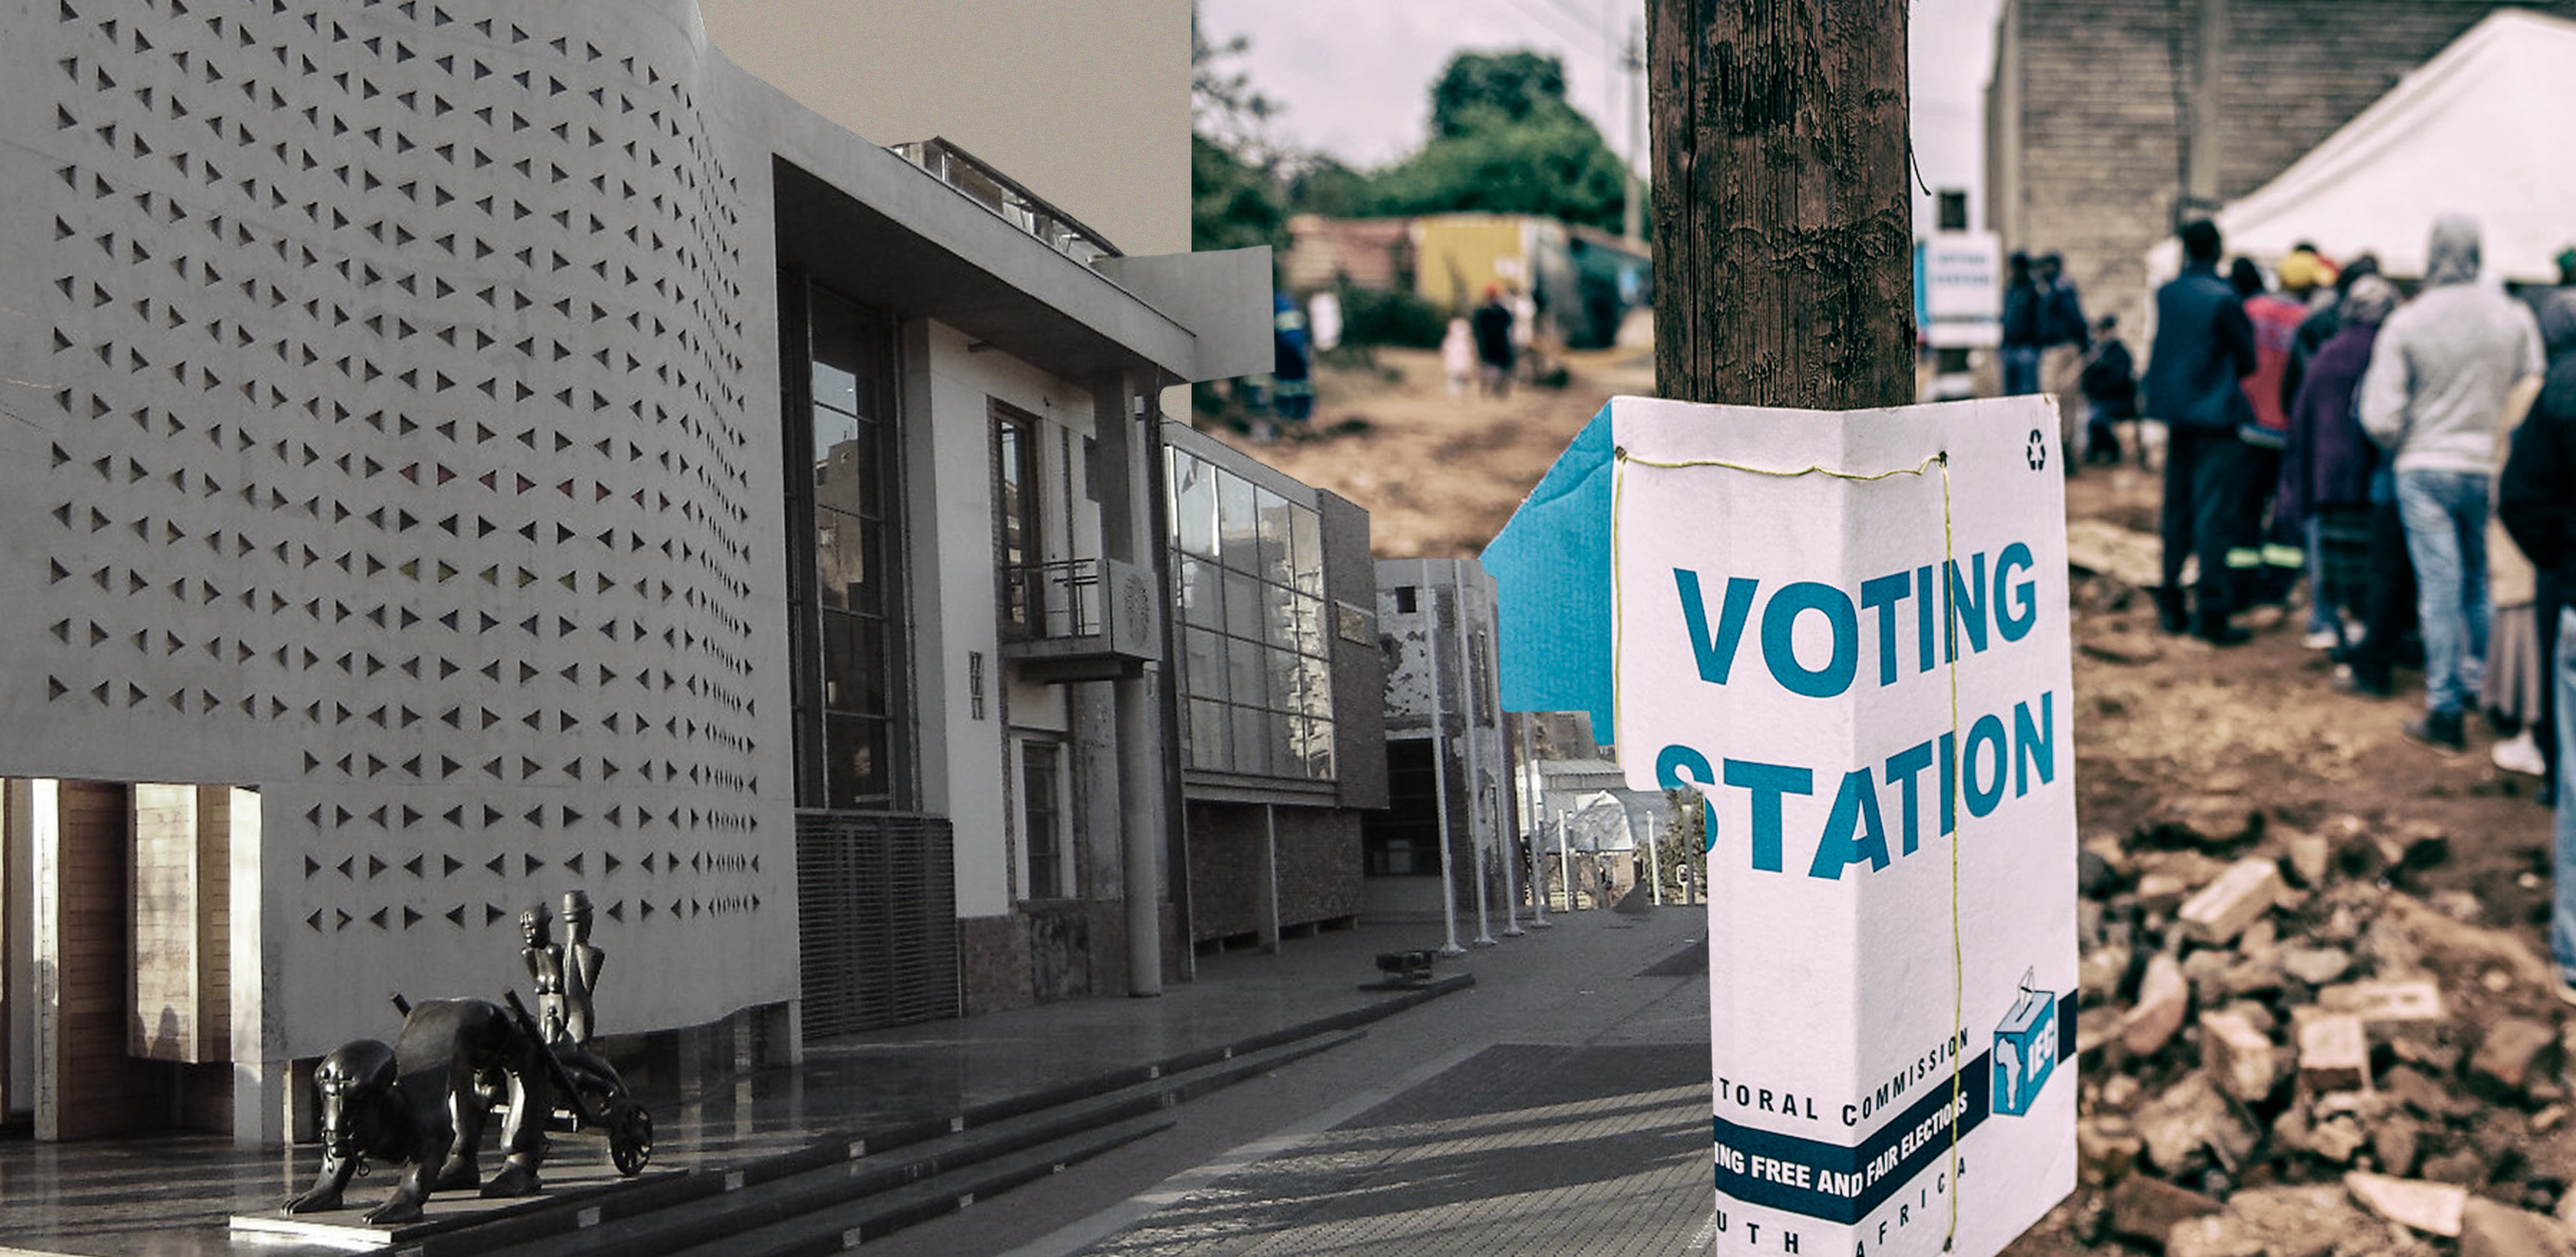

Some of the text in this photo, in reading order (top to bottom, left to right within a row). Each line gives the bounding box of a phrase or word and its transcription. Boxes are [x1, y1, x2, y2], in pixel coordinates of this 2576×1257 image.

[1673, 541, 2036, 698] VOTING
[1719, 1027, 1967, 1126] TORAL COMMISSION
[2028, 1017, 2054, 1083] IEC
[1752, 1155, 1810, 1189] FREE
[1817, 1169, 1863, 1198] AND
[1866, 1145, 1898, 1187] FAIR
[1856, 1157, 1965, 1257] AFRICA
